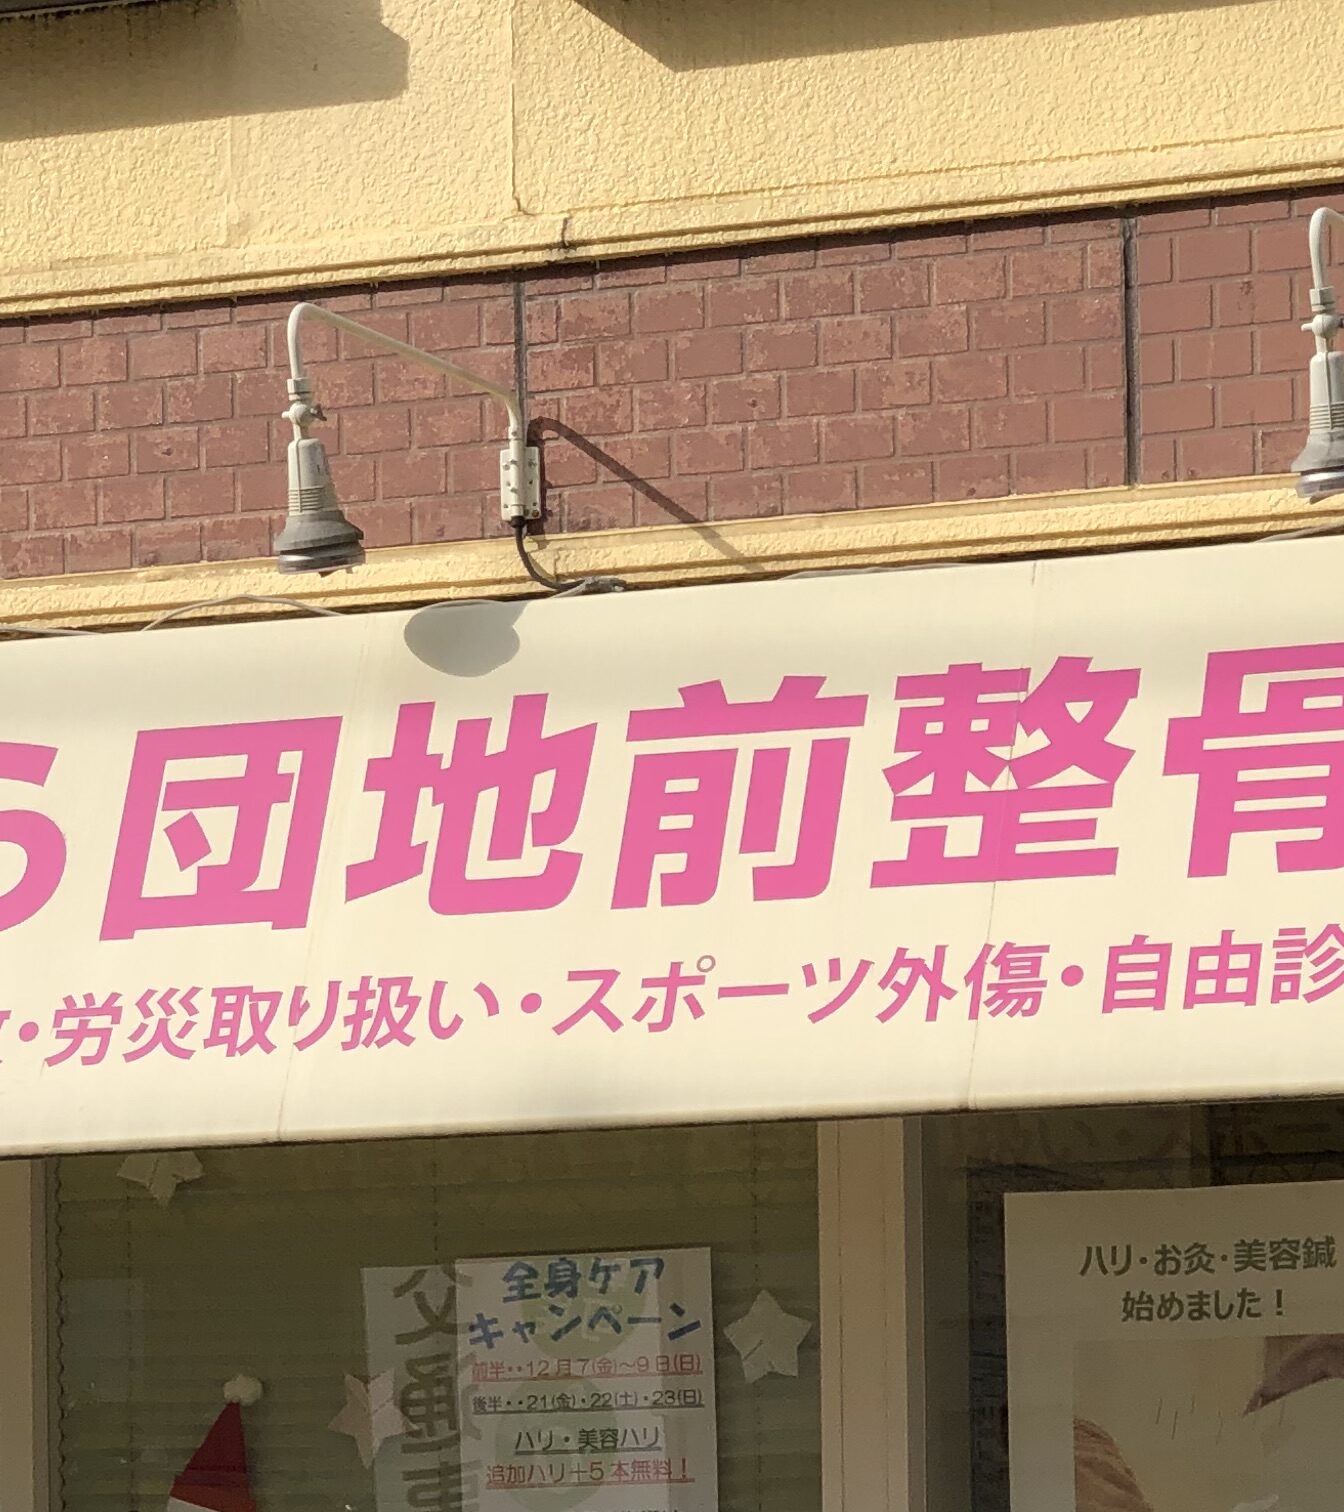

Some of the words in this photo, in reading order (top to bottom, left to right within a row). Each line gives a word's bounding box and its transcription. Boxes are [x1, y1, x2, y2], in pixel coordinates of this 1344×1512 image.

[1079, 1236, 1338, 1277] ハリ・お灸・美容鍼
[501, 1256, 665, 1303] 全身ケア
[468, 1302, 703, 1350] キャンペーン
[1121, 1287, 1287, 1324] 始めました！
